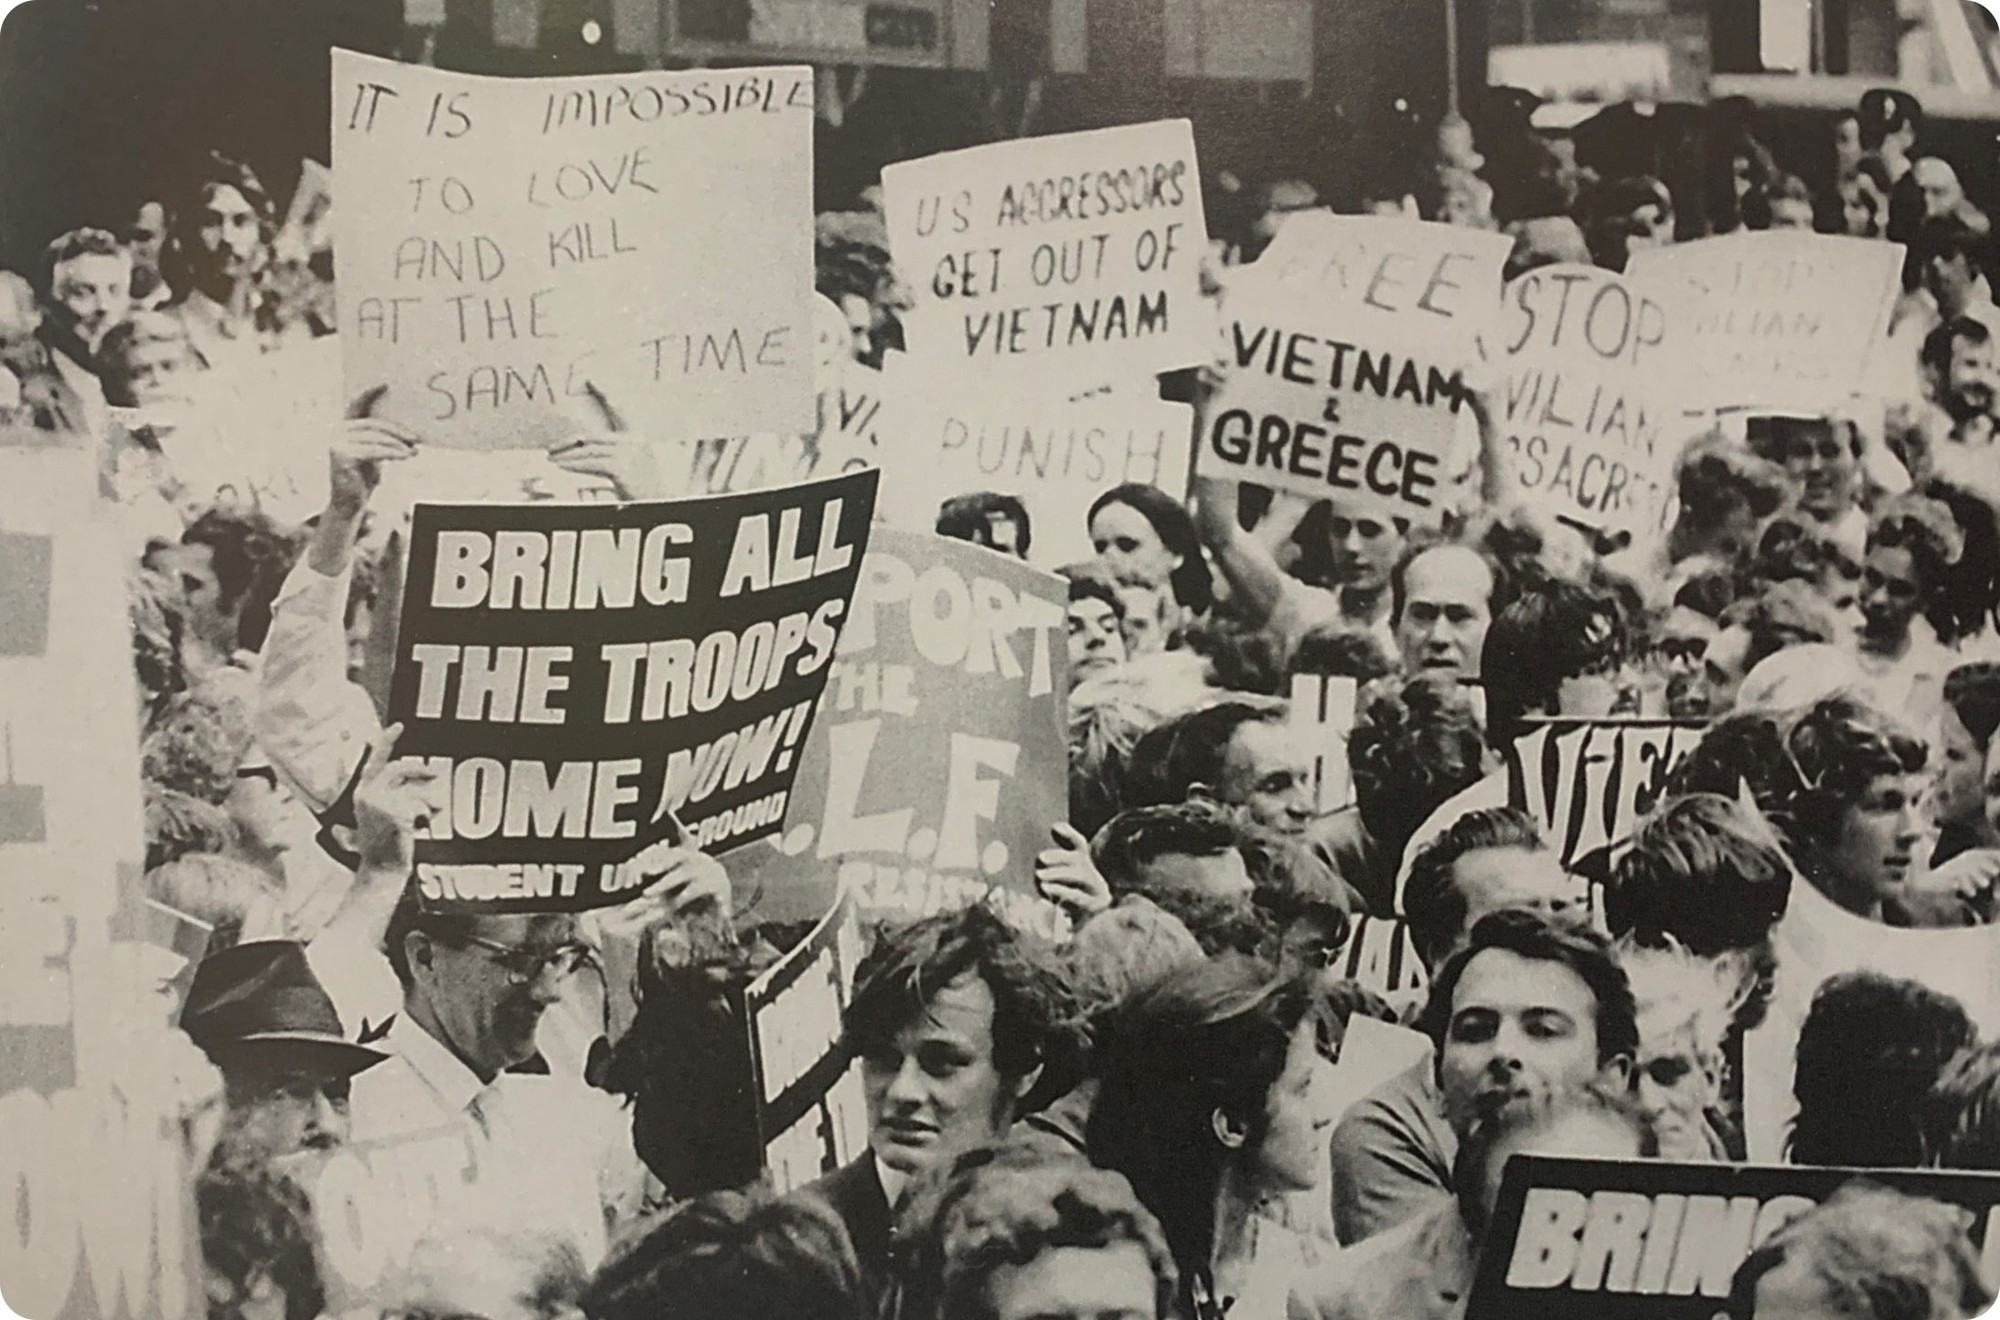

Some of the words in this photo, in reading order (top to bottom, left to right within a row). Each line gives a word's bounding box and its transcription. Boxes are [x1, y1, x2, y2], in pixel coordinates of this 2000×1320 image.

[348, 83, 400, 132] IT
[426, 93, 471, 138] IS
[543, 77, 815, 134] IMPOSSIBLE
[409, 177, 474, 214] TO
[527, 145, 660, 207] LOVE
[915, 190, 973, 237] US
[996, 159, 1186, 228] AGGRESSORS
[394, 236, 505, 283] AND
[548, 218, 638, 268] KILL
[931, 248, 1003, 299] GET
[1031, 233, 1110, 287] OUT
[1135, 223, 1184, 272] OF
[358, 296, 421, 344] AT
[445, 289, 559, 343] THE
[963, 289, 1169, 357] VIETNAM
[1507, 273, 1667, 366] STOP
[640, 326, 792, 381] TIME
[1232, 320, 1465, 414] VIETNAM
[940, 416, 1166, 486] PUNISH
[1211, 408, 1439, 507] GREECE
[430, 523, 694, 610] BRING
[719, 497, 855, 597] ALL
[412, 643, 573, 724] THE
[601, 598, 845, 724] TROOPS
[398, 755, 642, 840] HOME
[650, 699, 812, 824] NOW!
[416, 863, 585, 900] STUDENT
